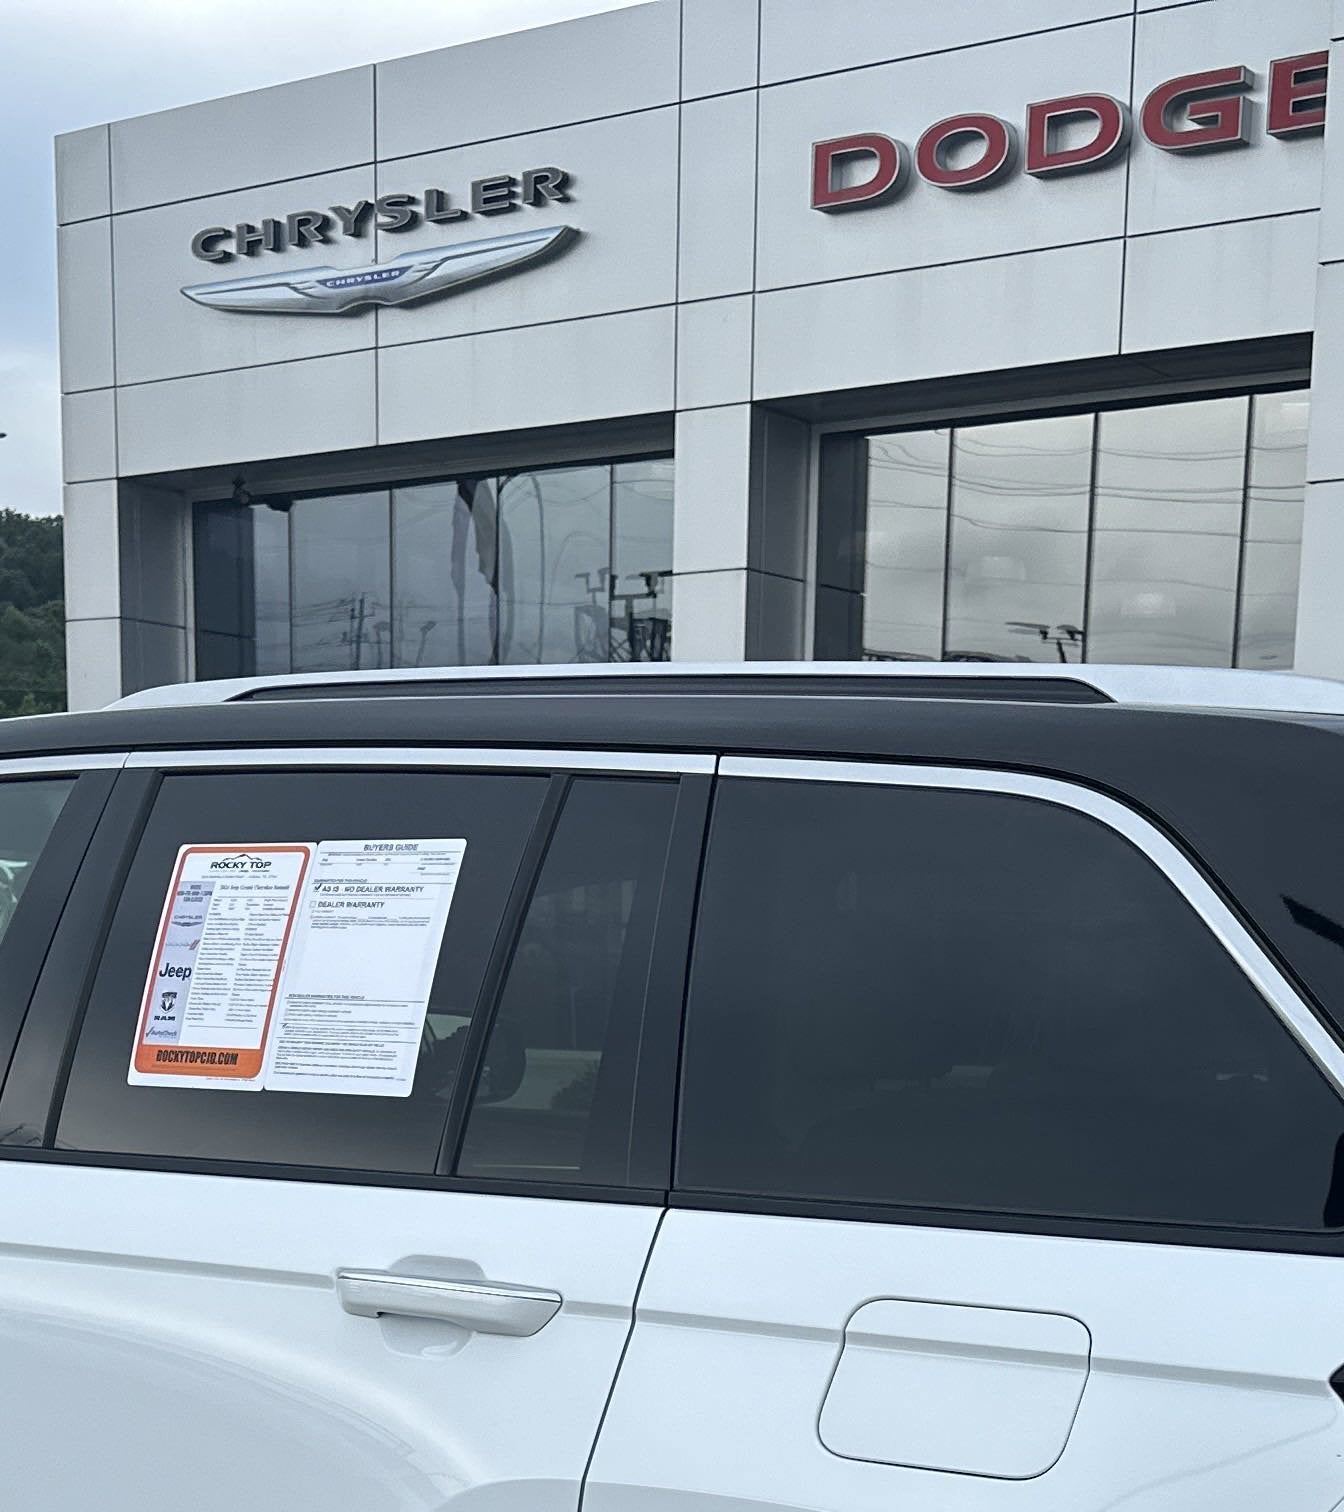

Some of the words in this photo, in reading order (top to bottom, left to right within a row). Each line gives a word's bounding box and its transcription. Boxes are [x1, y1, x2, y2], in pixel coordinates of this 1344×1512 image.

[811, 50, 1328, 211] DODGE
[191, 166, 567, 262] CHRYSLER
[326, 271, 399, 287] CHRYSLER
[363, 844, 393, 852] BUYERS
[395, 843, 419, 851] GUIDE
[210, 861, 247, 869] ROCKY
[250, 861, 272, 869] TOP
[346, 901, 385, 909] WARRANTY
[159, 962, 192, 981] Jeep
